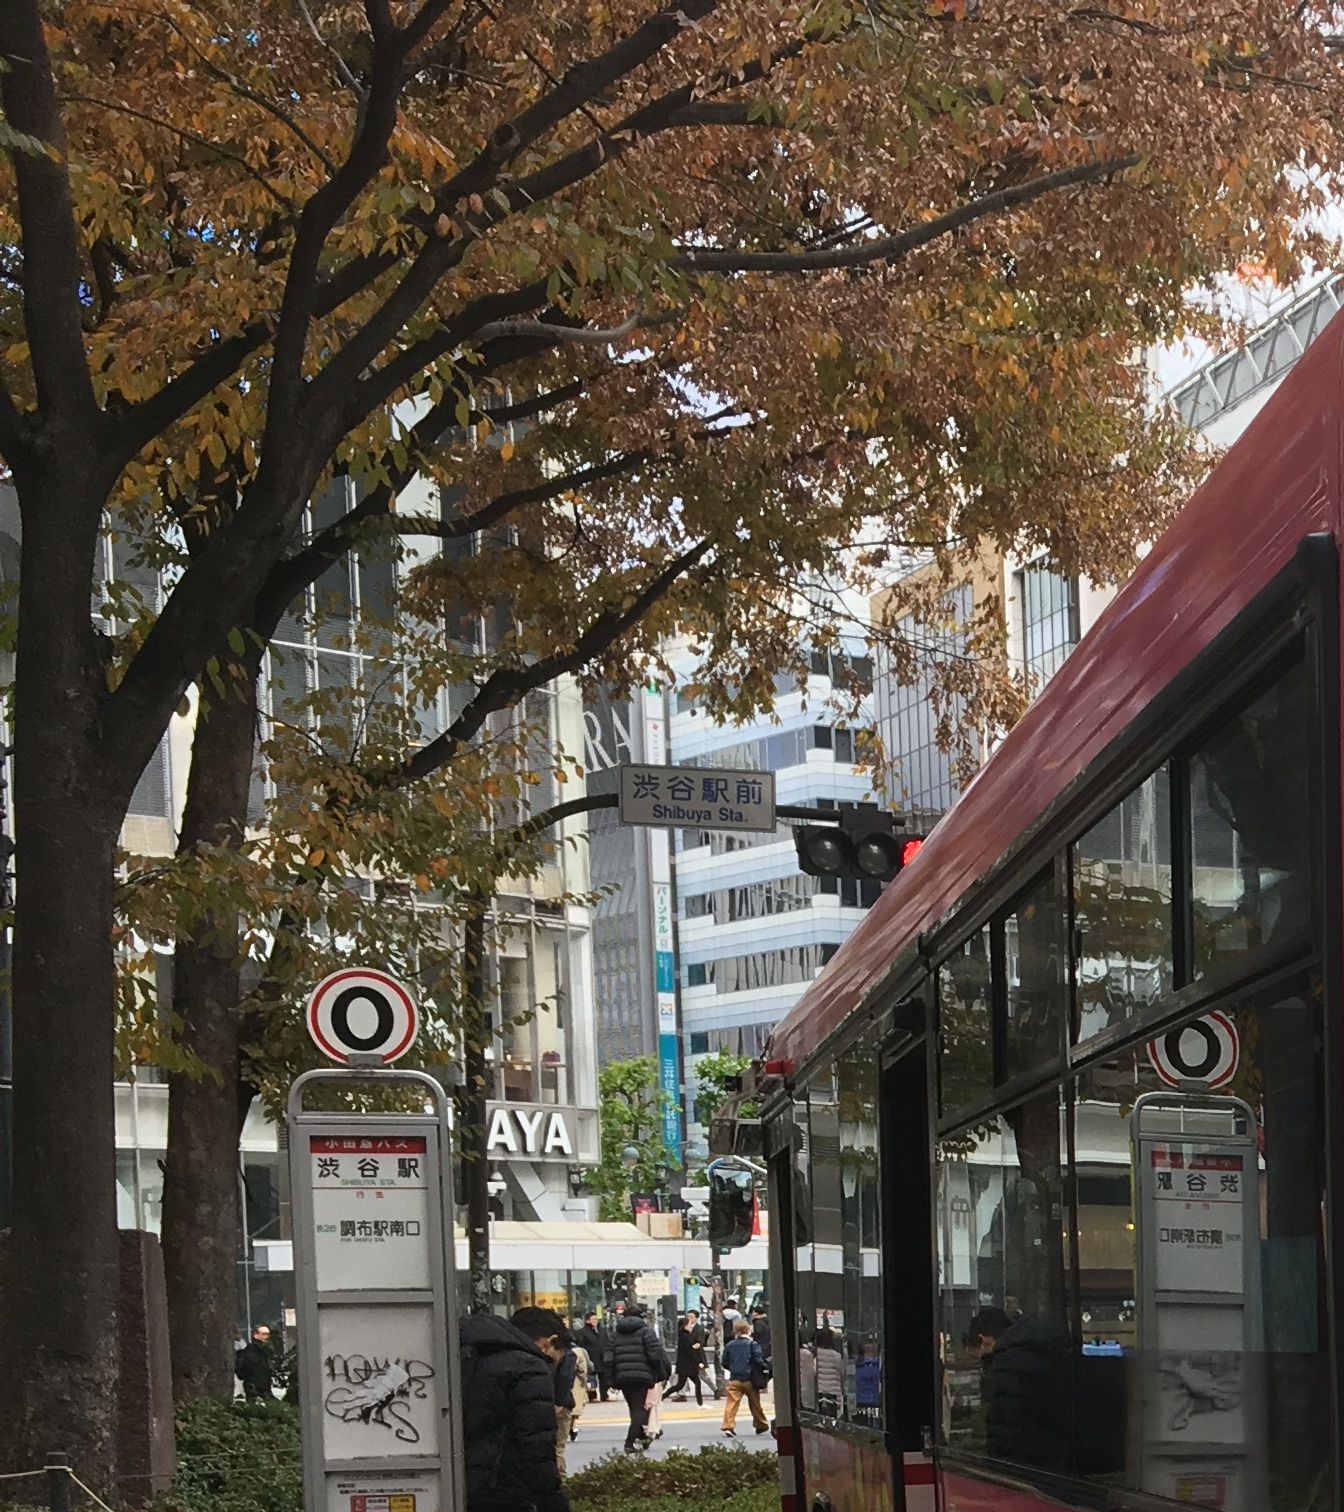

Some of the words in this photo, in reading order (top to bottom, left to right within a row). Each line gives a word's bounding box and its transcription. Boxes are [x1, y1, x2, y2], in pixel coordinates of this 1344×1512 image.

[632, 773, 763, 805] 渋谷駅前
[652, 804, 712, 824] Shibuya
[719, 807, 748, 823] Sta.
[317, 1157, 420, 1178] 渋谷駅
[340, 1220, 420, 1237] 調布駅南口
